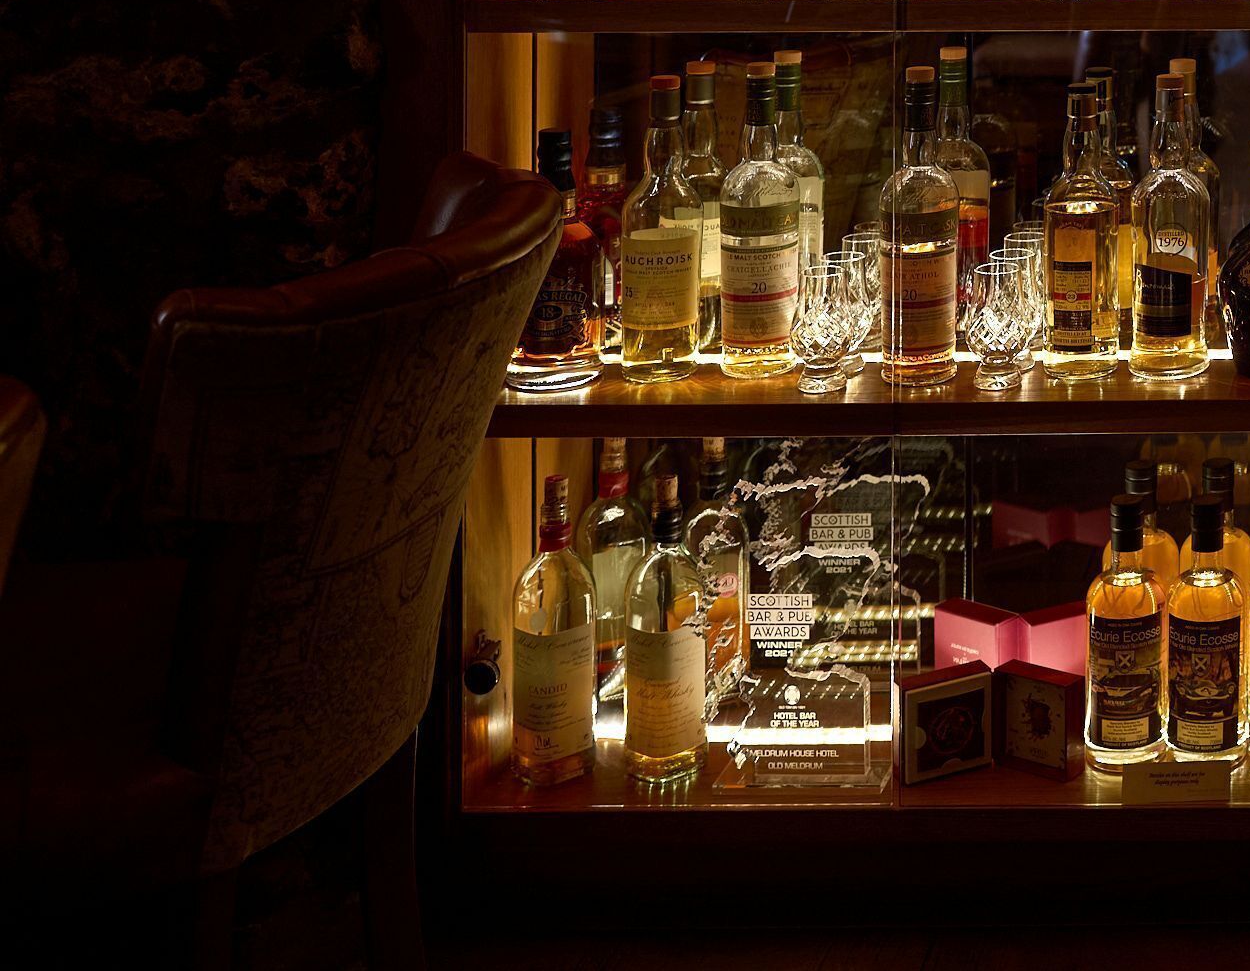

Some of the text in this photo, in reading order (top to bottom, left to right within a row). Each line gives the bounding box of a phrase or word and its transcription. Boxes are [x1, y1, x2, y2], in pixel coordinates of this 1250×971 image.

[1158, 237, 1185, 247] 1976
[625, 253, 693, 266] AUCHROISK
[753, 253, 780, 261] SCOTCH
[910, 271, 939, 280] ATHOL
[751, 282, 767, 294] 20
[551, 291, 584, 303] REGAL
[902, 289, 918, 301] 20
[542, 307, 554, 318] 18
[814, 515, 869, 525] SCOTTISH
[811, 529, 872, 539] BAR & PUB
[826, 566, 852, 574] 2021
[750, 595, 810, 606] SCOTTISH
[748, 611, 772, 622] BAR
[777, 612, 785, 622] &
[834, 620, 857, 630] HOEL
[753, 626, 807, 637] AWARDS
[859, 627, 878, 635] YEAR
[1091, 626, 1161, 643] Ecurie Ecosse
[1170, 626, 1239, 646] Ecurie Ecosse
[756, 641, 803, 649] WINNER
[765, 649, 794, 657] 2021
[662, 685, 696, 700] Whisky
[773, 712, 817, 720] HOTEL BAR
[750, 749, 839, 757] MELDRUM HOUSE HOTEL
[768, 761, 824, 769] OLD MELDRUM
